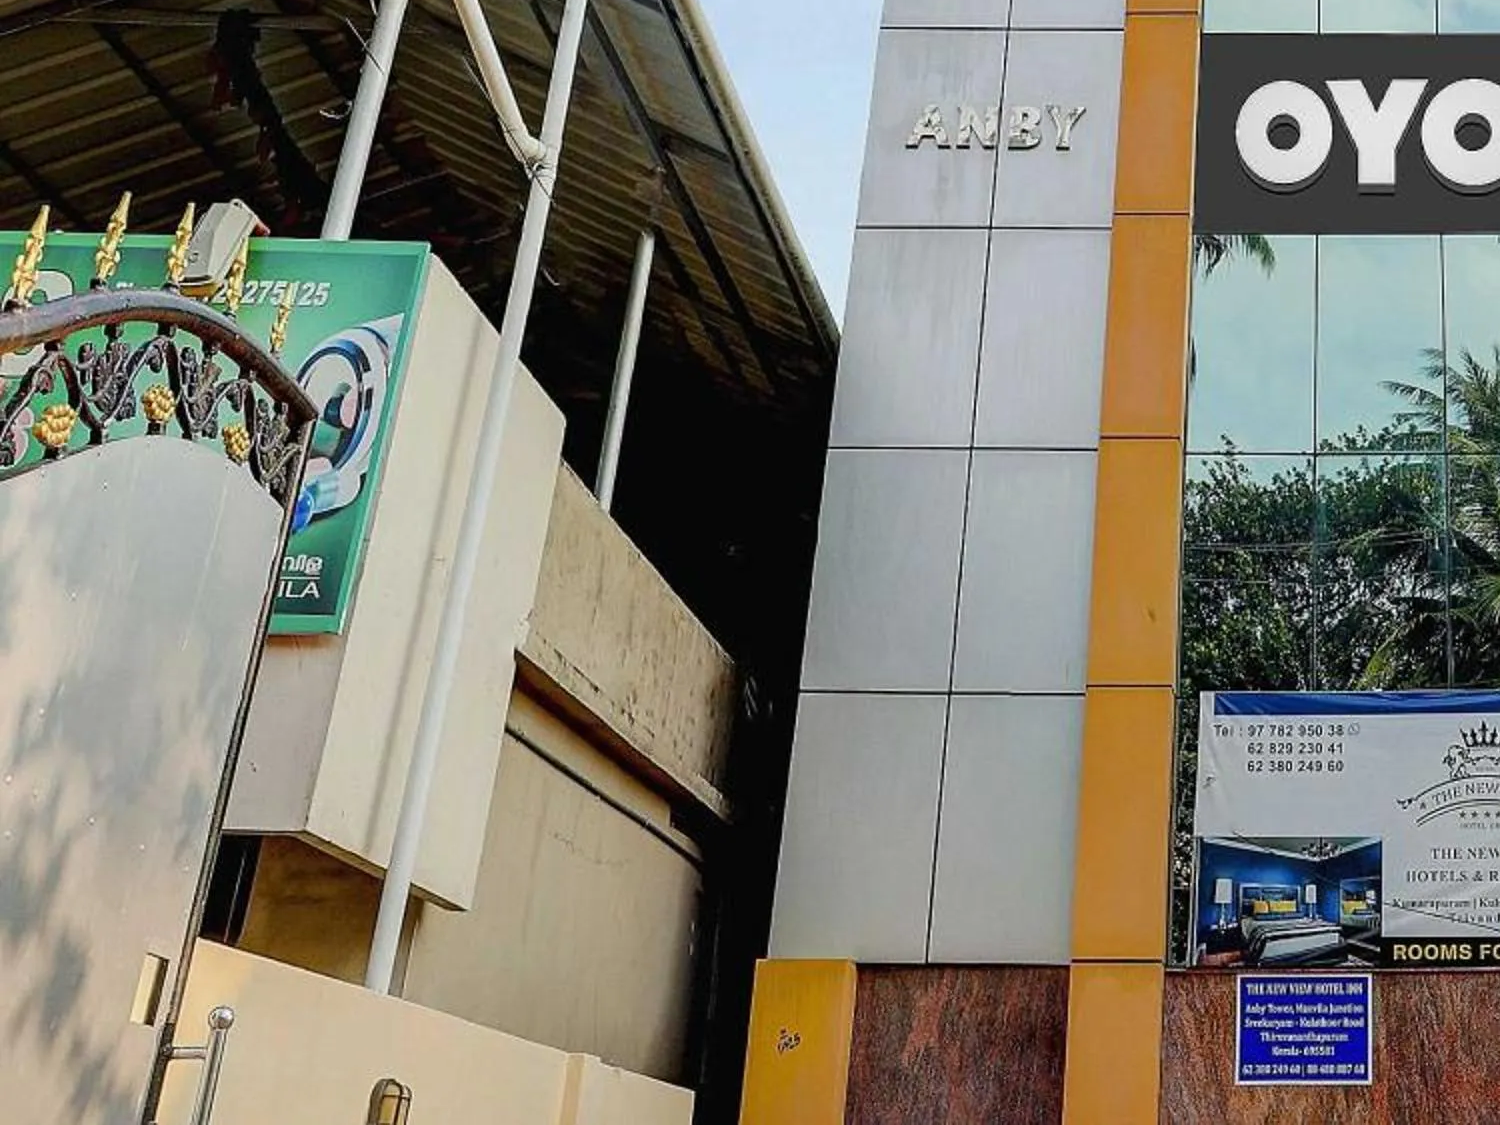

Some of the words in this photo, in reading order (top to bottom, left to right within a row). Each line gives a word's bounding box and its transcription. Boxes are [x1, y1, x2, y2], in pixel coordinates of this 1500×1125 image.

[904, 104, 1087, 150] ANBY
[1213, 724, 1234, 737] Tel
[1248, 725, 1264, 737] 97
[1269, 725, 1293, 737] 782
[1298, 725, 1322, 737] 950
[1327, 725, 1344, 737] 38
[1247, 742, 1264, 755] 62
[1269, 742, 1293, 755] 829
[1299, 742, 1322, 755] 230
[1327, 742, 1343, 755] 41
[1247, 760, 1263, 772] 62
[1268, 760, 1293, 772] 380
[1298, 760, 1322, 772] 249
[1327, 760, 1344, 772] 60
[1432, 787, 1462, 805] THE
[1465, 782, 1500, 795] NEW
[1431, 847, 1463, 860] THE
[1407, 870, 1467, 883] HOTELS
[1393, 943, 1472, 960] ROOMS
